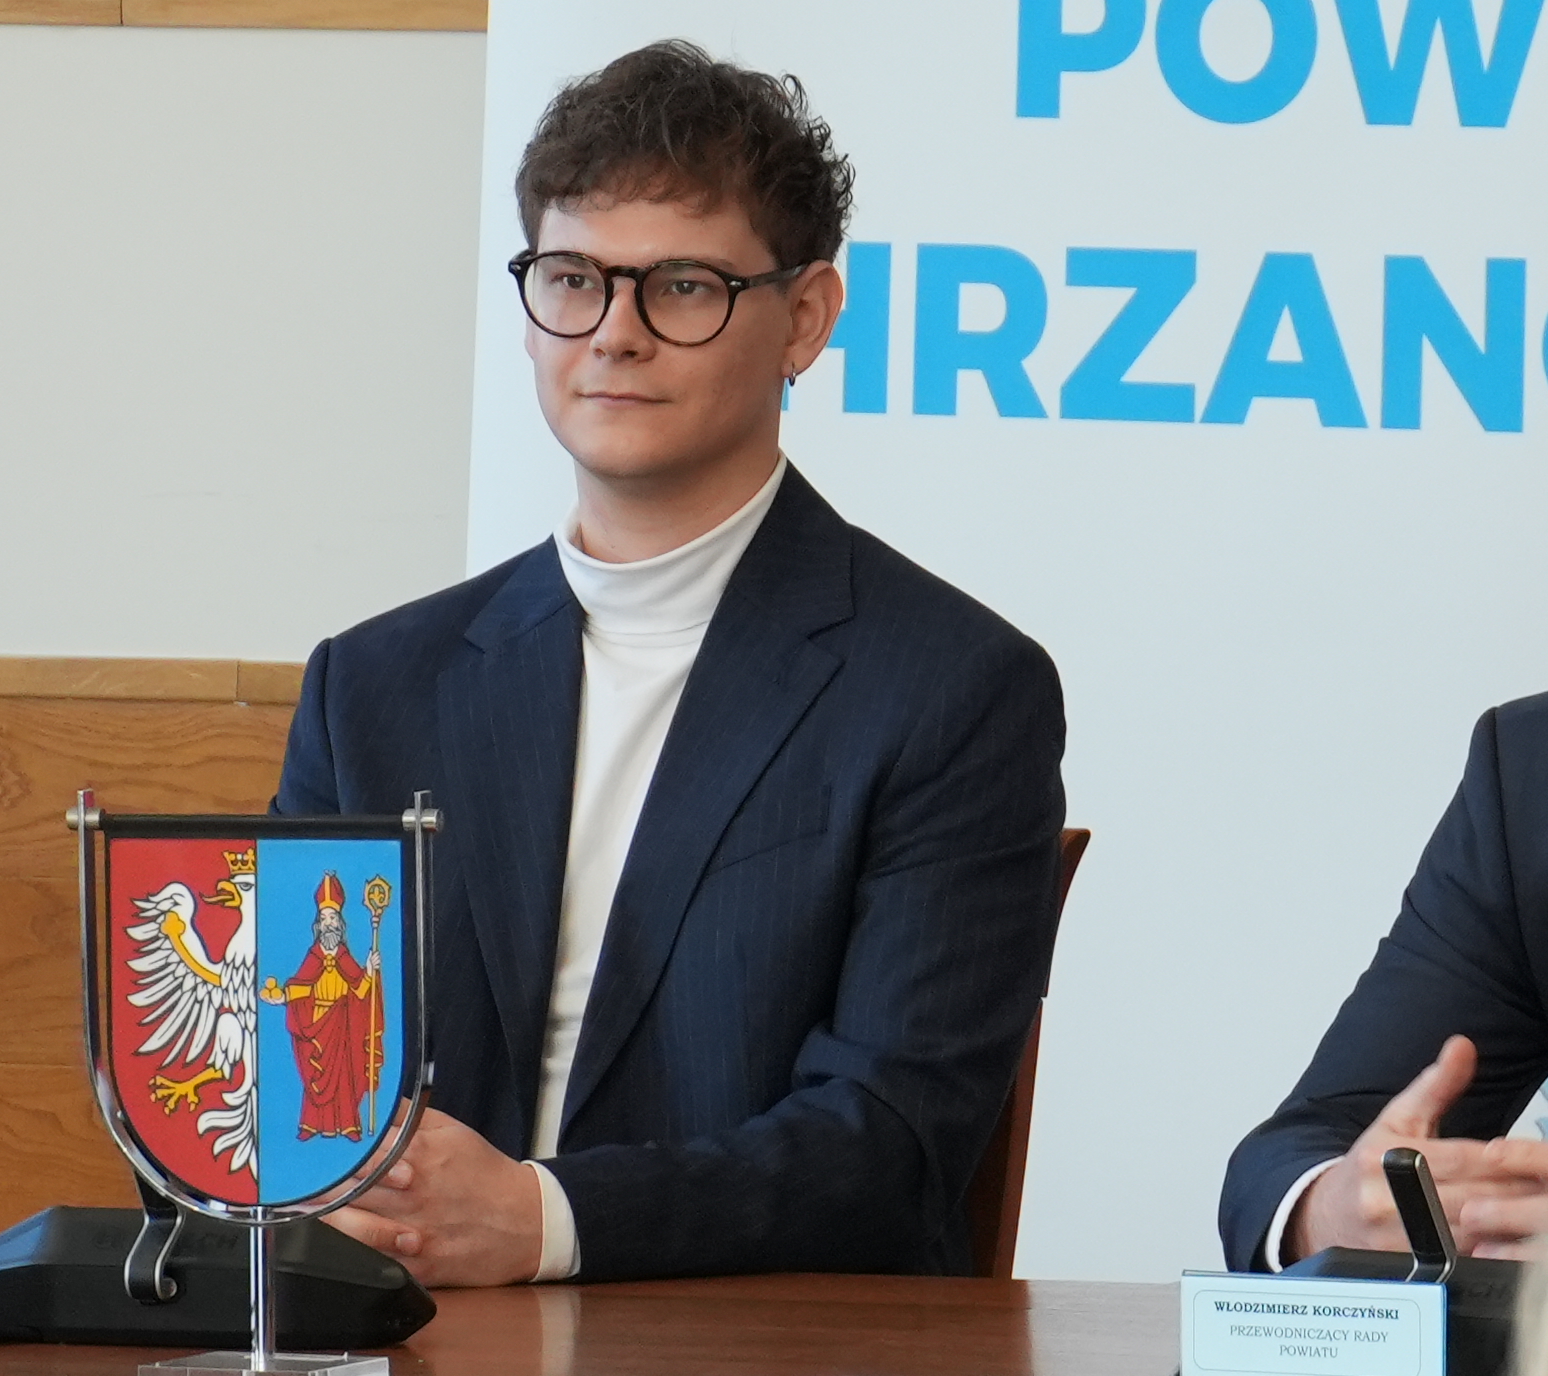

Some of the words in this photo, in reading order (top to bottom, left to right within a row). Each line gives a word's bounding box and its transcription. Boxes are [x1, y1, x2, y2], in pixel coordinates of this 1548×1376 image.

[1214, 1300, 1308, 1316] WŁODZIMIERZ
[1312, 1304, 1400, 1320] KORCZYŃSKI
[1229, 1324, 1350, 1342] PRZEWODNICZĄCY
[1353, 1330, 1389, 1343] RADY
[1279, 1344, 1339, 1359] POWIATU
